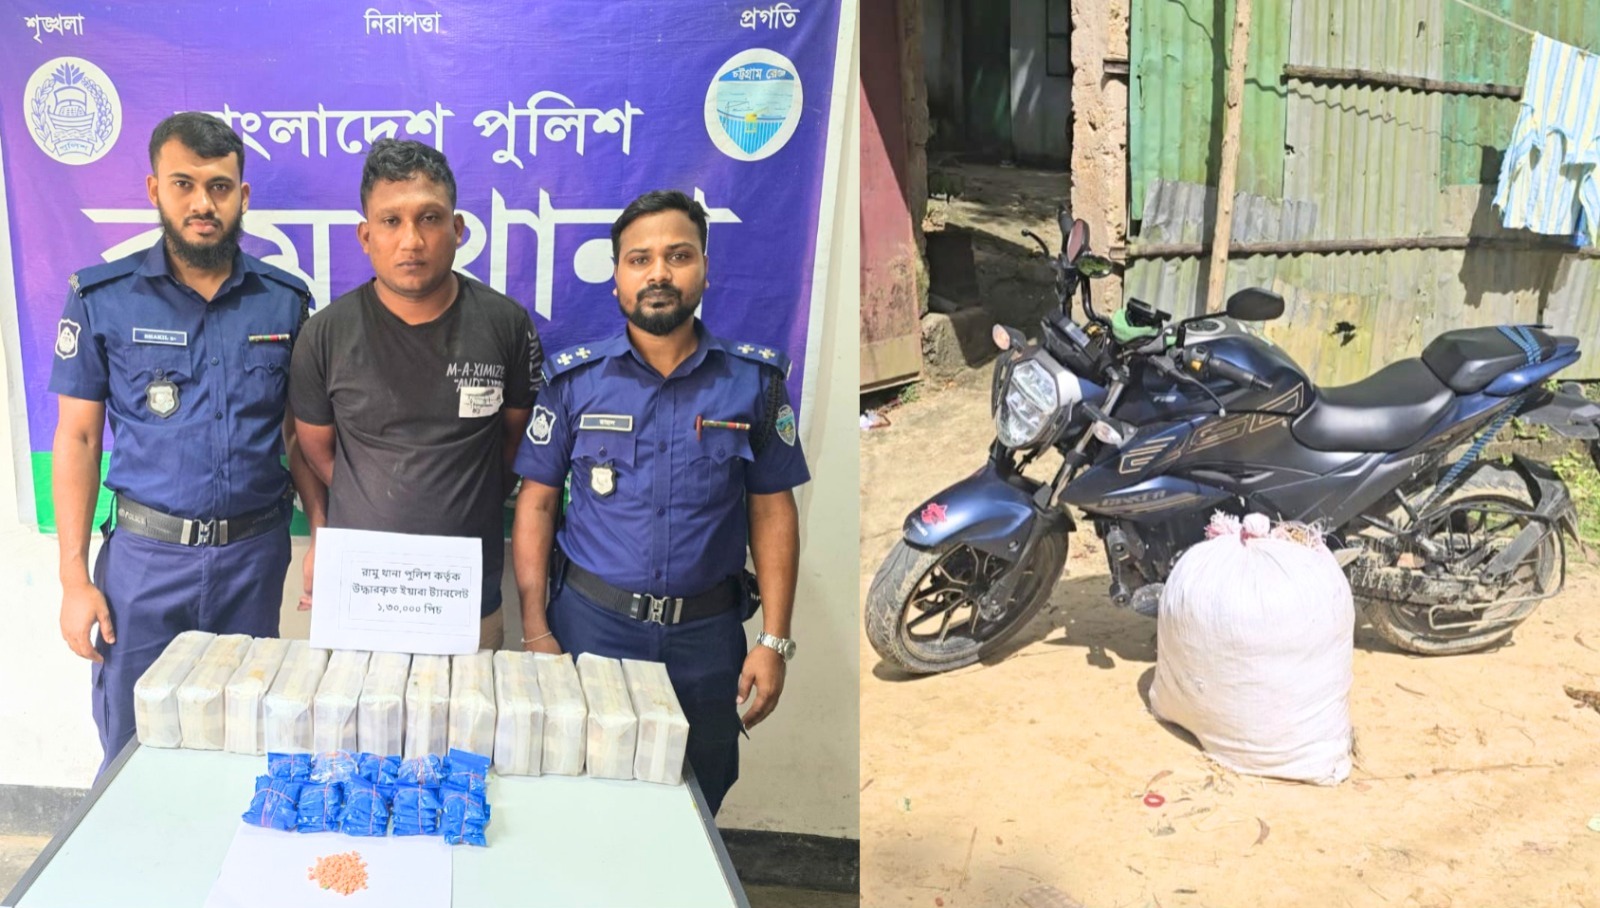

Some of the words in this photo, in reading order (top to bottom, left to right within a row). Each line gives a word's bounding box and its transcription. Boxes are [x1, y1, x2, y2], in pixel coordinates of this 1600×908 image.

[23, 12, 86, 44] শৃঙ্খলা
[363, 7, 442, 35] নিরাপত্তা
[739, 2, 801, 31] প্রগতি
[174, 102, 456, 161] াংলাদেশ
[472, 90, 645, 169] পুলিশ
[361, 567, 380, 580] রামু
[381, 568, 402, 578] থানা
[404, 567, 432, 581] পুলিশ
[433, 569, 461, 583] কর্তৃক
[352, 583, 398, 596] উদ্ধারকৃত
[429, 586, 469, 599] ট্যাবলেট
[377, 603, 421, 614] ১,৩০,০০০
[423, 602, 443, 615] পিচ
